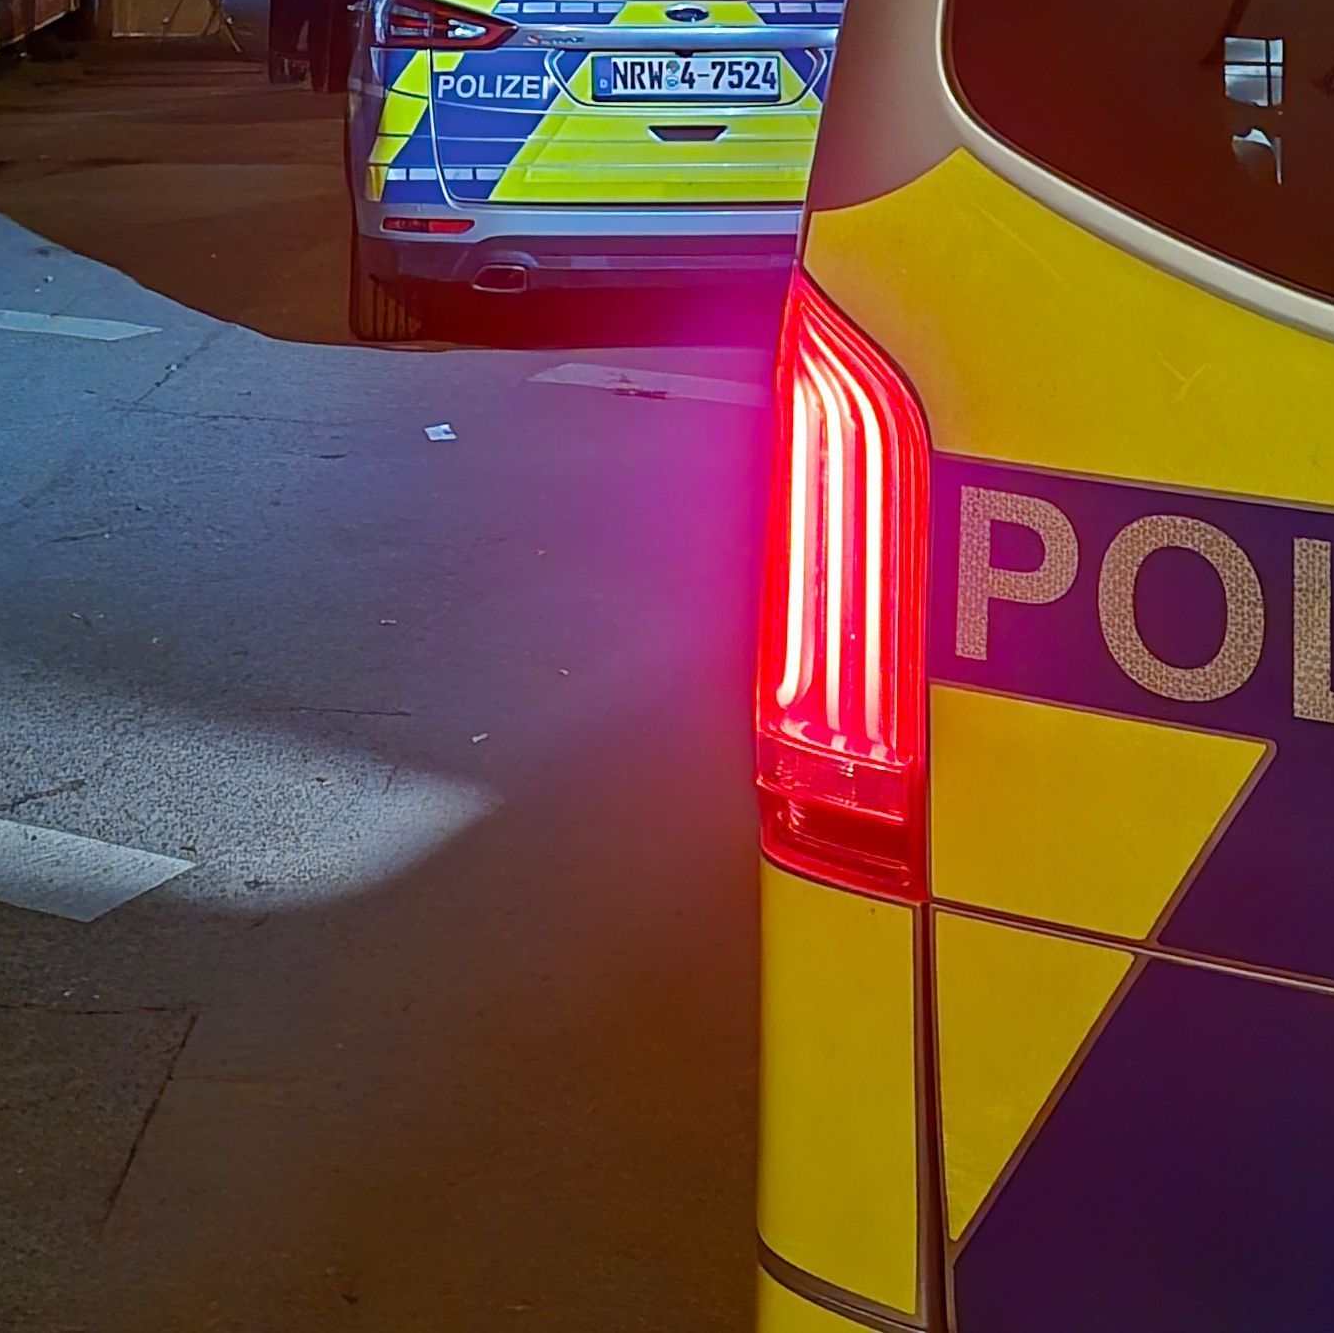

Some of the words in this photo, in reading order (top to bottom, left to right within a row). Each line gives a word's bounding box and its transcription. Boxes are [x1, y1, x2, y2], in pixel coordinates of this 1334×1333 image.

[437, 74, 549, 101] POLIZEI
[612, 61, 665, 91] NRW
[679, 60, 777, 91] 4-7524
